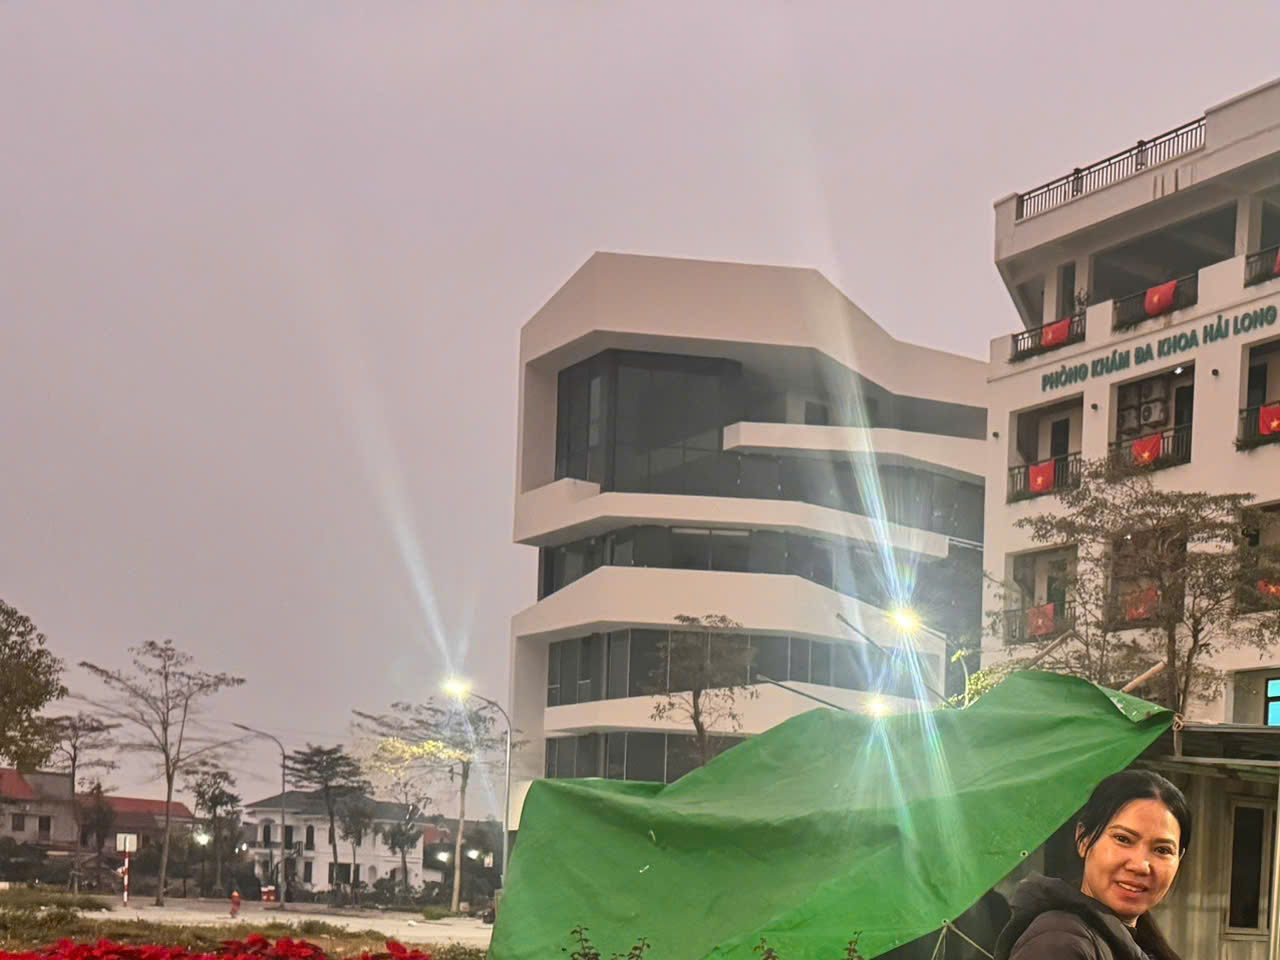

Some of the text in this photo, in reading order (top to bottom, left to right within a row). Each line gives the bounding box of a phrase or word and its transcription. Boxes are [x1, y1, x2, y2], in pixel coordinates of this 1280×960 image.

[1041, 306, 1277, 391] PHÒNG KHÁM ĐA KHOA HẢI LONG
